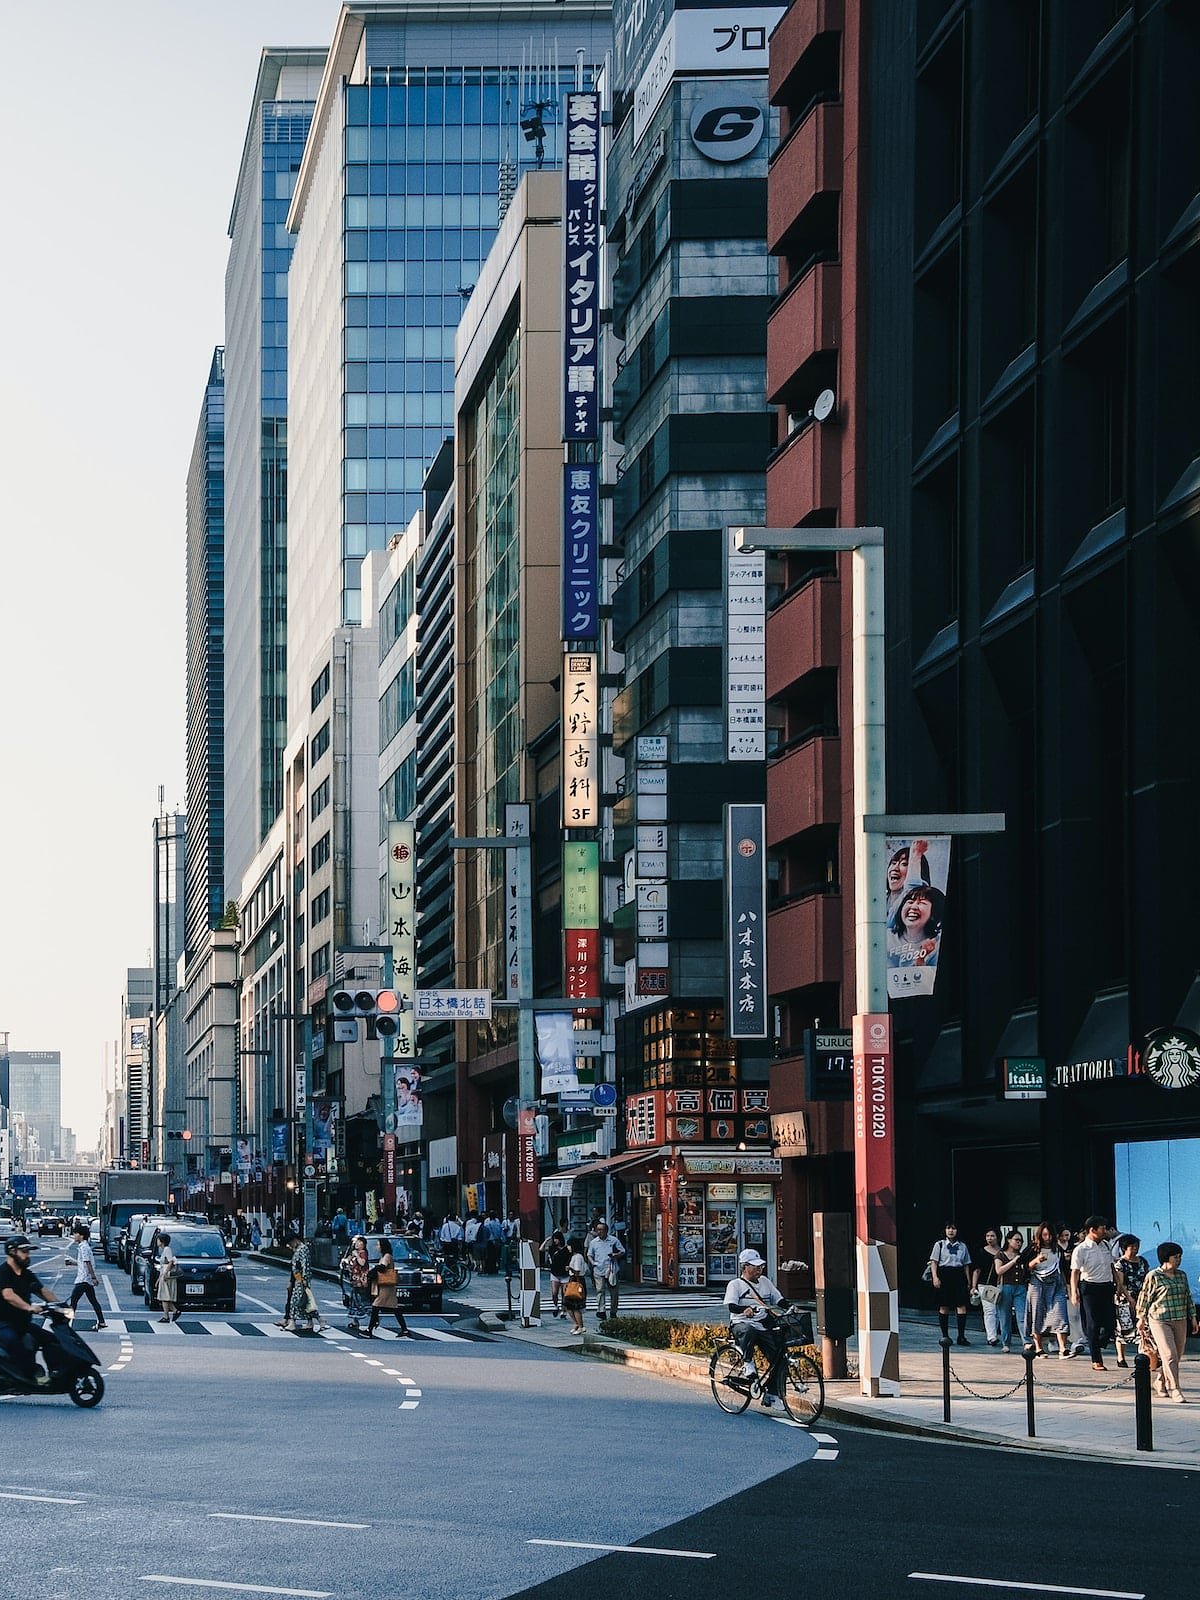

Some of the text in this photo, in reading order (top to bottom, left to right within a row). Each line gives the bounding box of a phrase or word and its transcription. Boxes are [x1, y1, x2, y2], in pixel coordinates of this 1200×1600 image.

[713, 24, 767, 52] プロ
[568, 95, 597, 181] 英会話
[583, 183, 596, 246] クイーンズ
[568, 250, 595, 393] イタリア語
[574, 396, 588, 433] チャオ
[570, 470, 591, 632] 恵友クリニック
[568, 682, 592, 800] 天野歯科
[572, 808, 591, 820] 3F
[391, 882, 412, 1054] 山本海店
[890, 943, 927, 963] FEEL 2020
[418, 1009, 456, 1017] Nihonbashi
[419, 997, 486, 1010] 日本橋北詰
[855, 1058, 863, 1103] TOKYO
[1056, 1059, 1114, 1085] TRATTORIA
[1127, 1044, 1147, 1076] It
[872, 1057, 885, 1138] TOKYO 2020
[526, 1136, 534, 1183] TOKYO 2020
